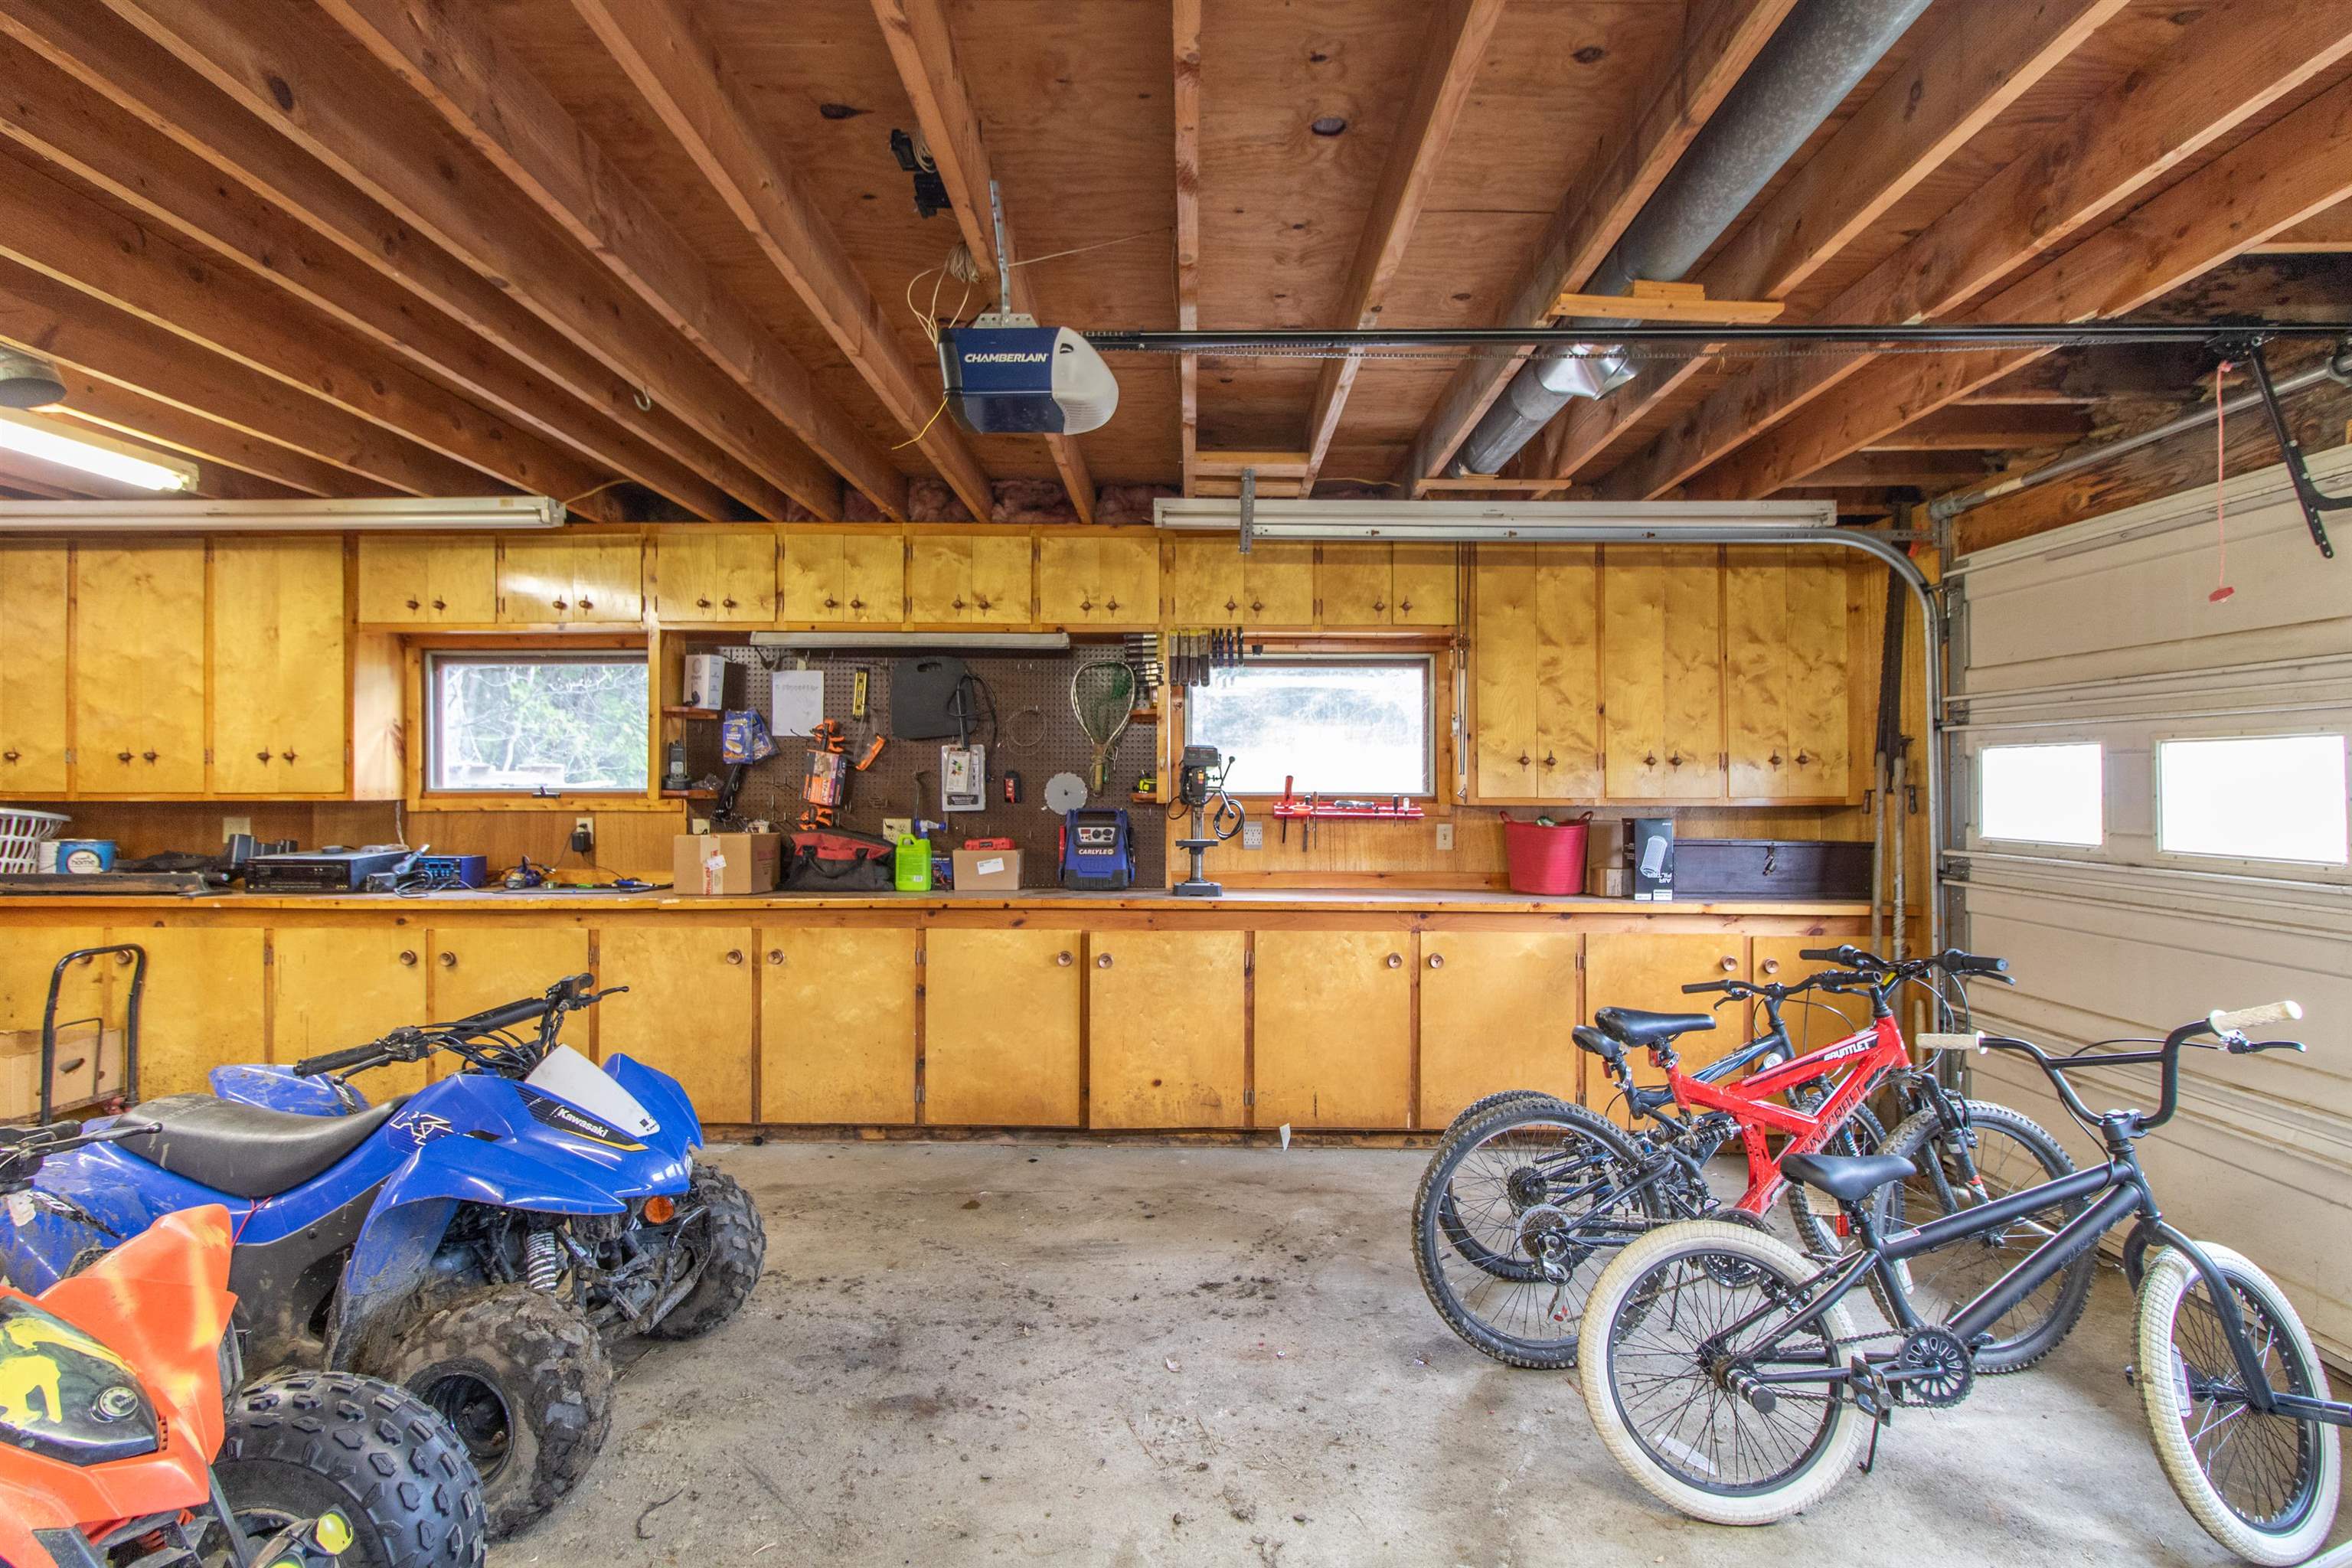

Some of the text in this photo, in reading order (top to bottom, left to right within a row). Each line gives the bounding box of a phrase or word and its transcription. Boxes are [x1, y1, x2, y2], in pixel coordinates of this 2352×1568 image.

[965, 352, 1047, 364] CHAMBERLAIN
[1824, 1040, 1870, 1061] GAUNTLET
[557, 1108, 609, 1138] Kawasaki
